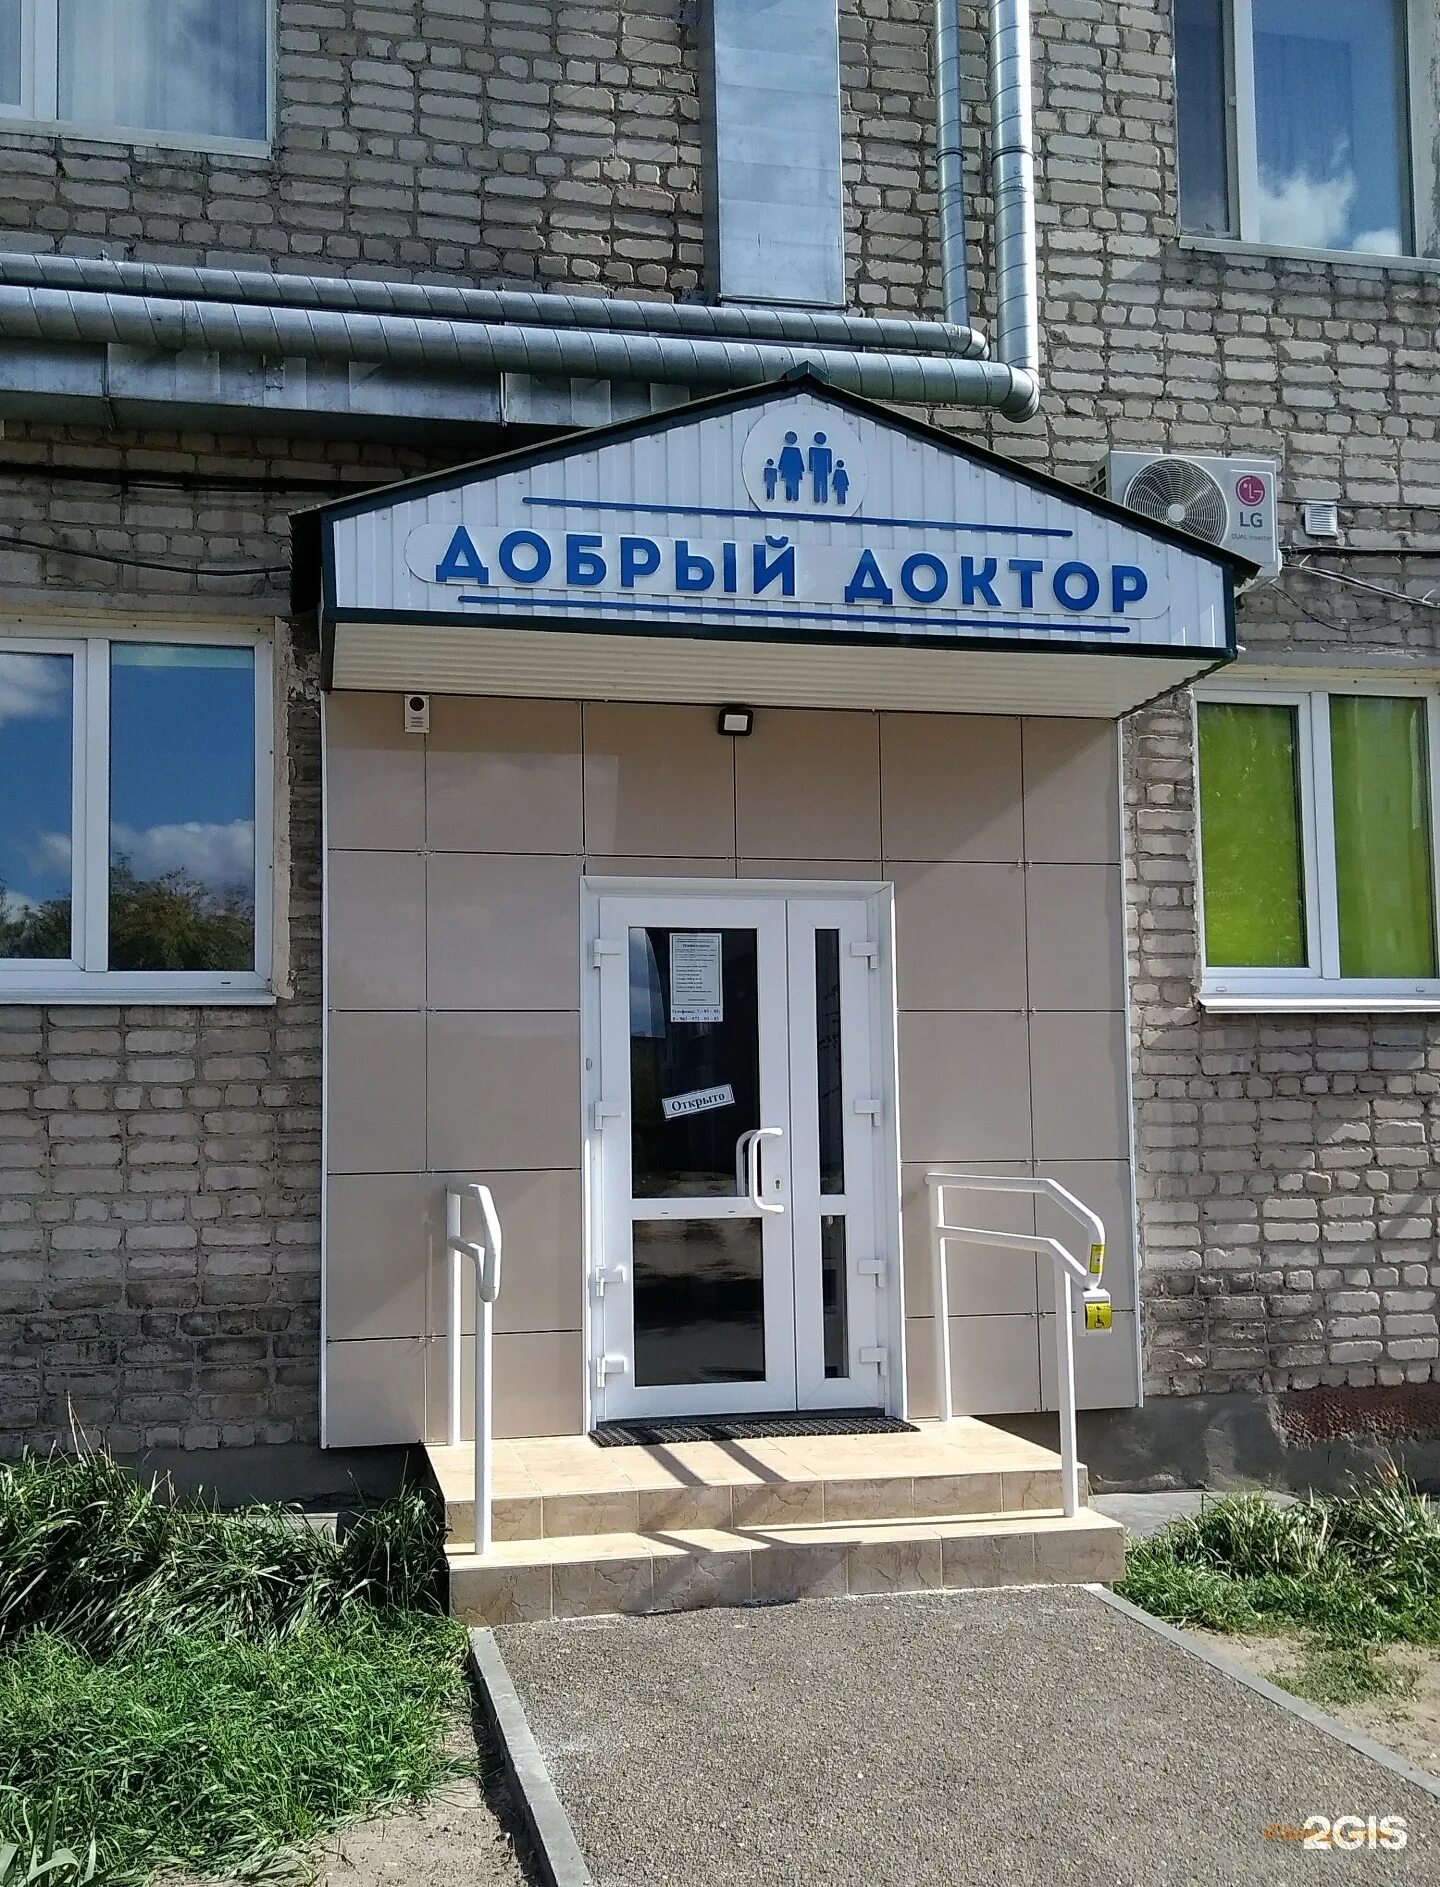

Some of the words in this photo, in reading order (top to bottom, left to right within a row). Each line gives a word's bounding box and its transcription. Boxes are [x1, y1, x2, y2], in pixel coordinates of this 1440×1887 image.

[1240, 512, 1263, 528] LG
[435, 525, 795, 597] ДОБРЫЙ
[844, 548, 1148, 613] ДОКТОР
[671, 1093, 725, 1111] Открыто
